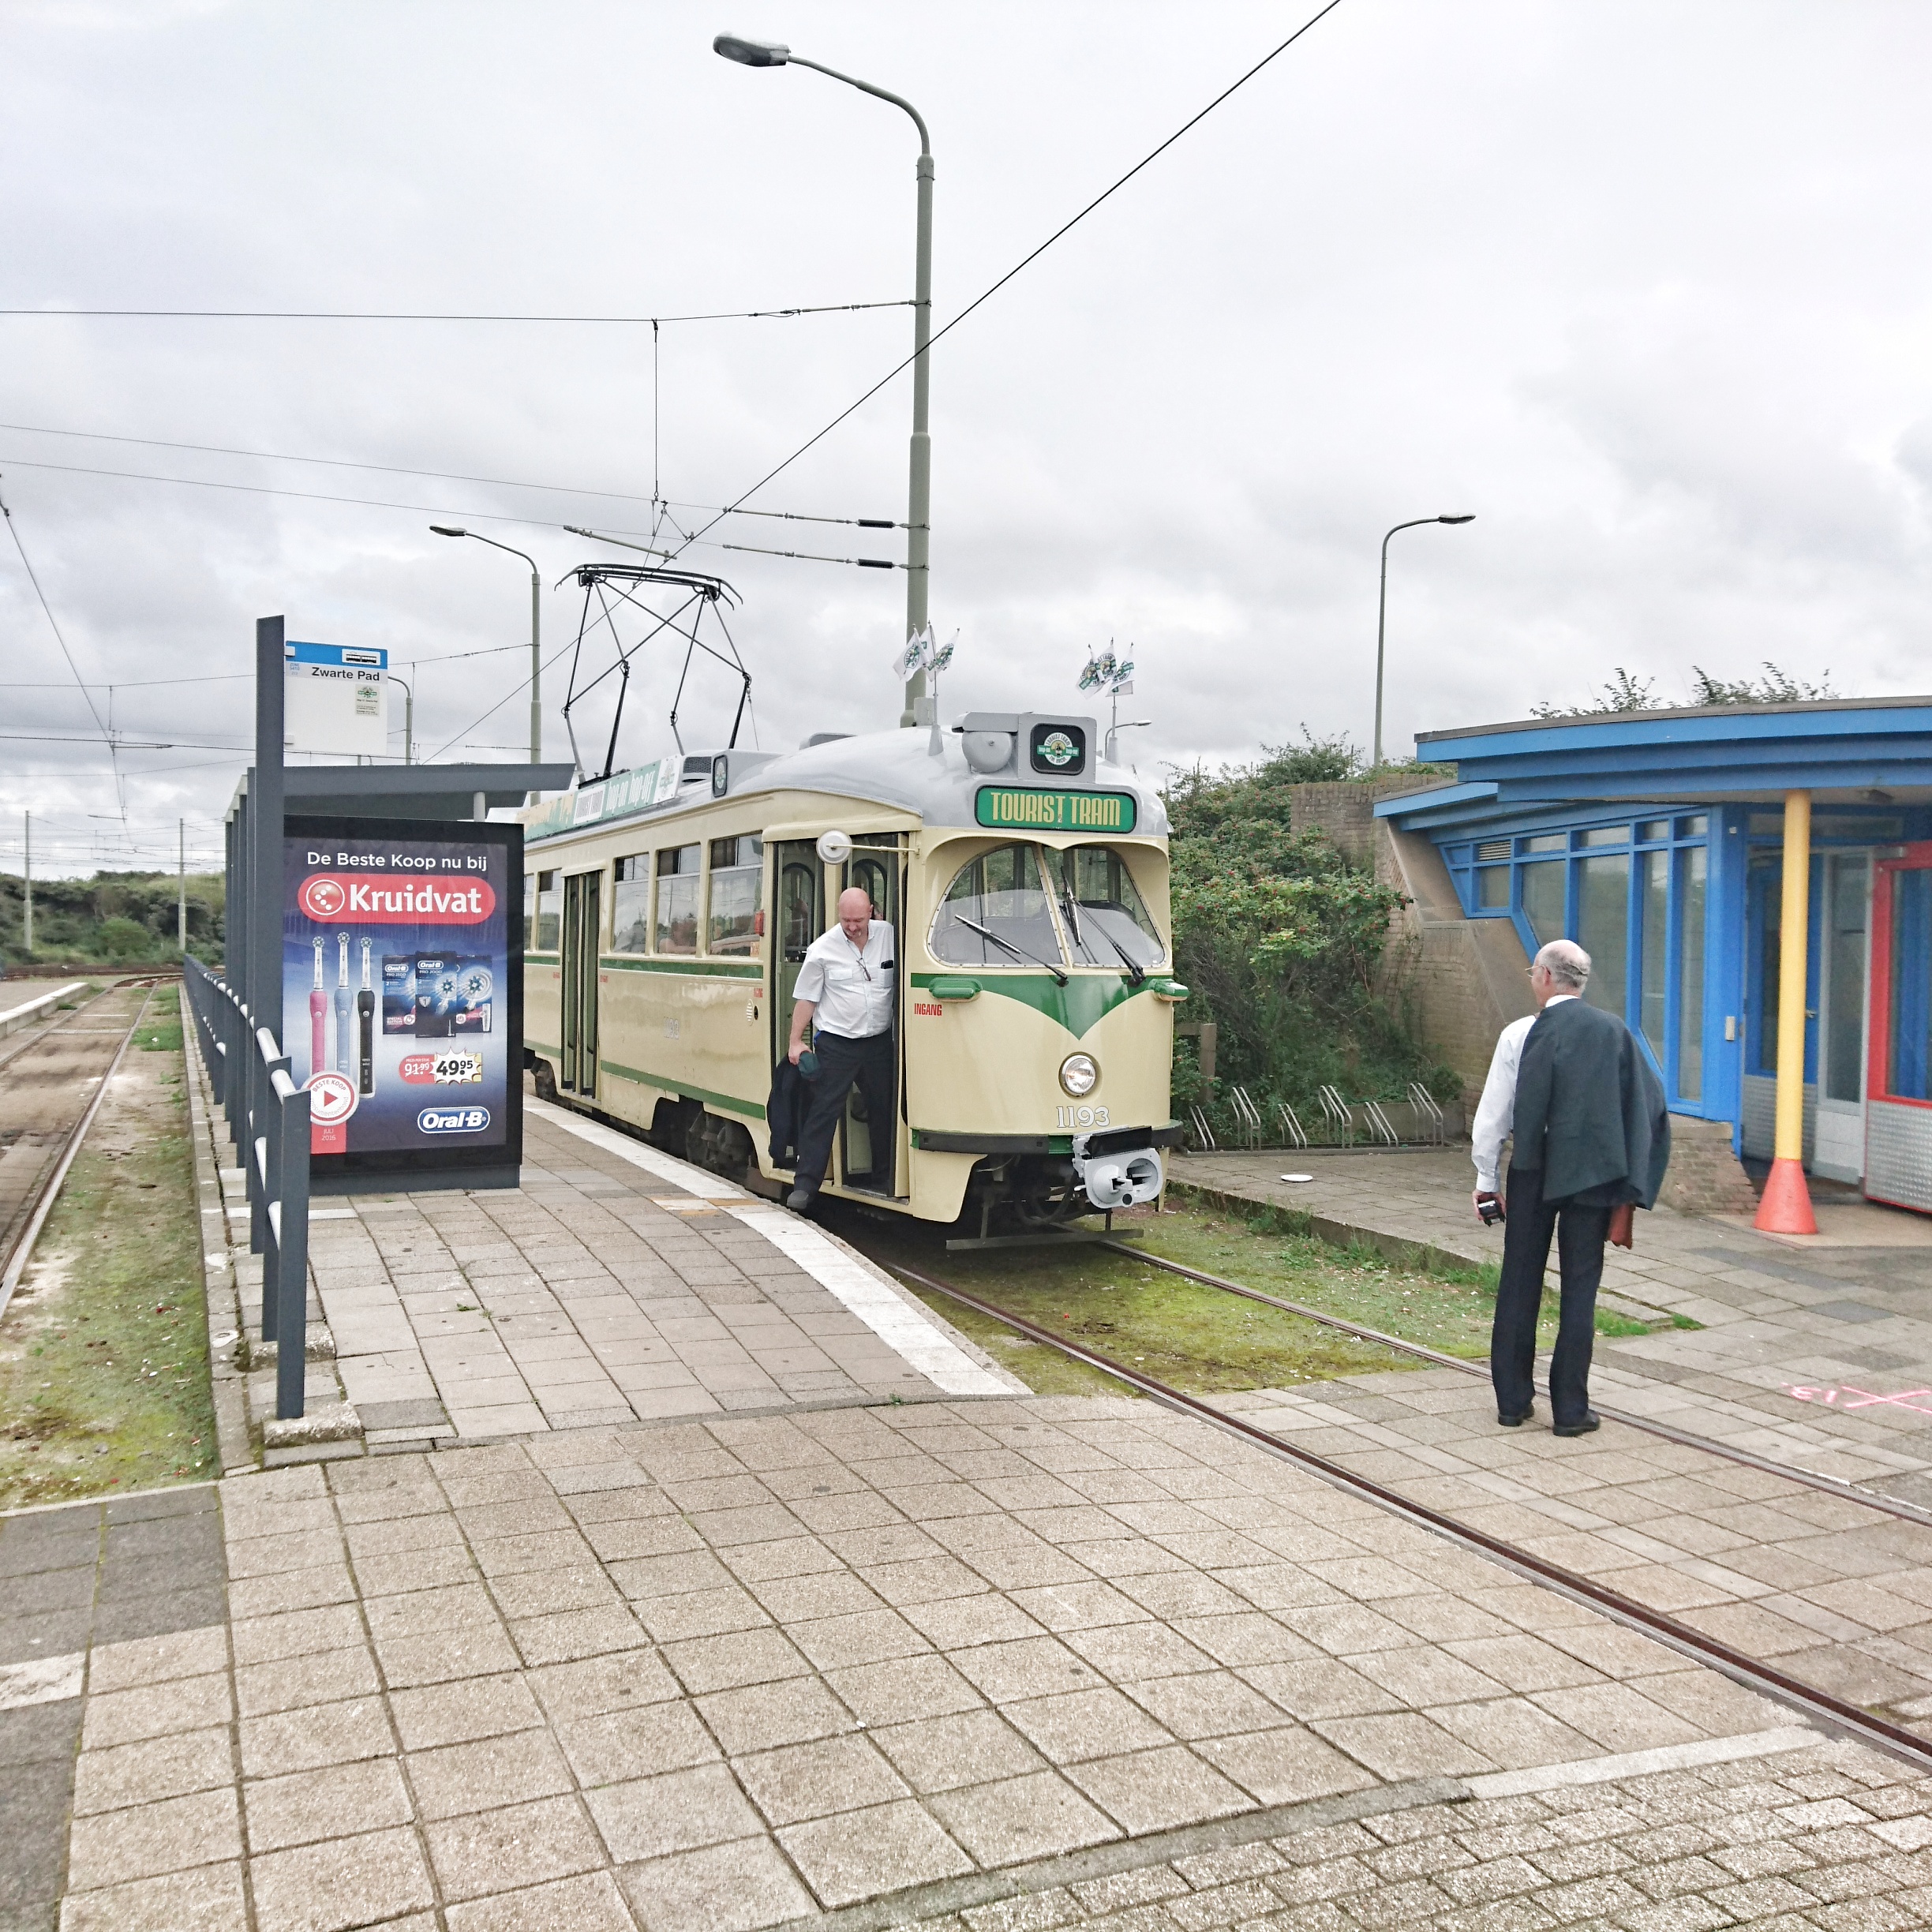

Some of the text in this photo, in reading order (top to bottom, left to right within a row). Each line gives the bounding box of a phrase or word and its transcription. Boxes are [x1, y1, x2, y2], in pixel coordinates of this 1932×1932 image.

[311, 667, 380, 681] Zwarte Pad
[606, 781, 629, 813] hop-on
[628, 770, 656, 806] hop-off
[990, 792, 1121, 826] TOURIST TRAM
[307, 852, 487, 871] De Beste Koop nu bij
[350, 884, 482, 913] Kruidvat
[914, 1003, 942, 1017] INGANG
[313, 1079, 346, 1092] BESTE KOOP
[422, 1111, 484, 1129] Oral-B
[1057, 1106, 1110, 1128] 1193
